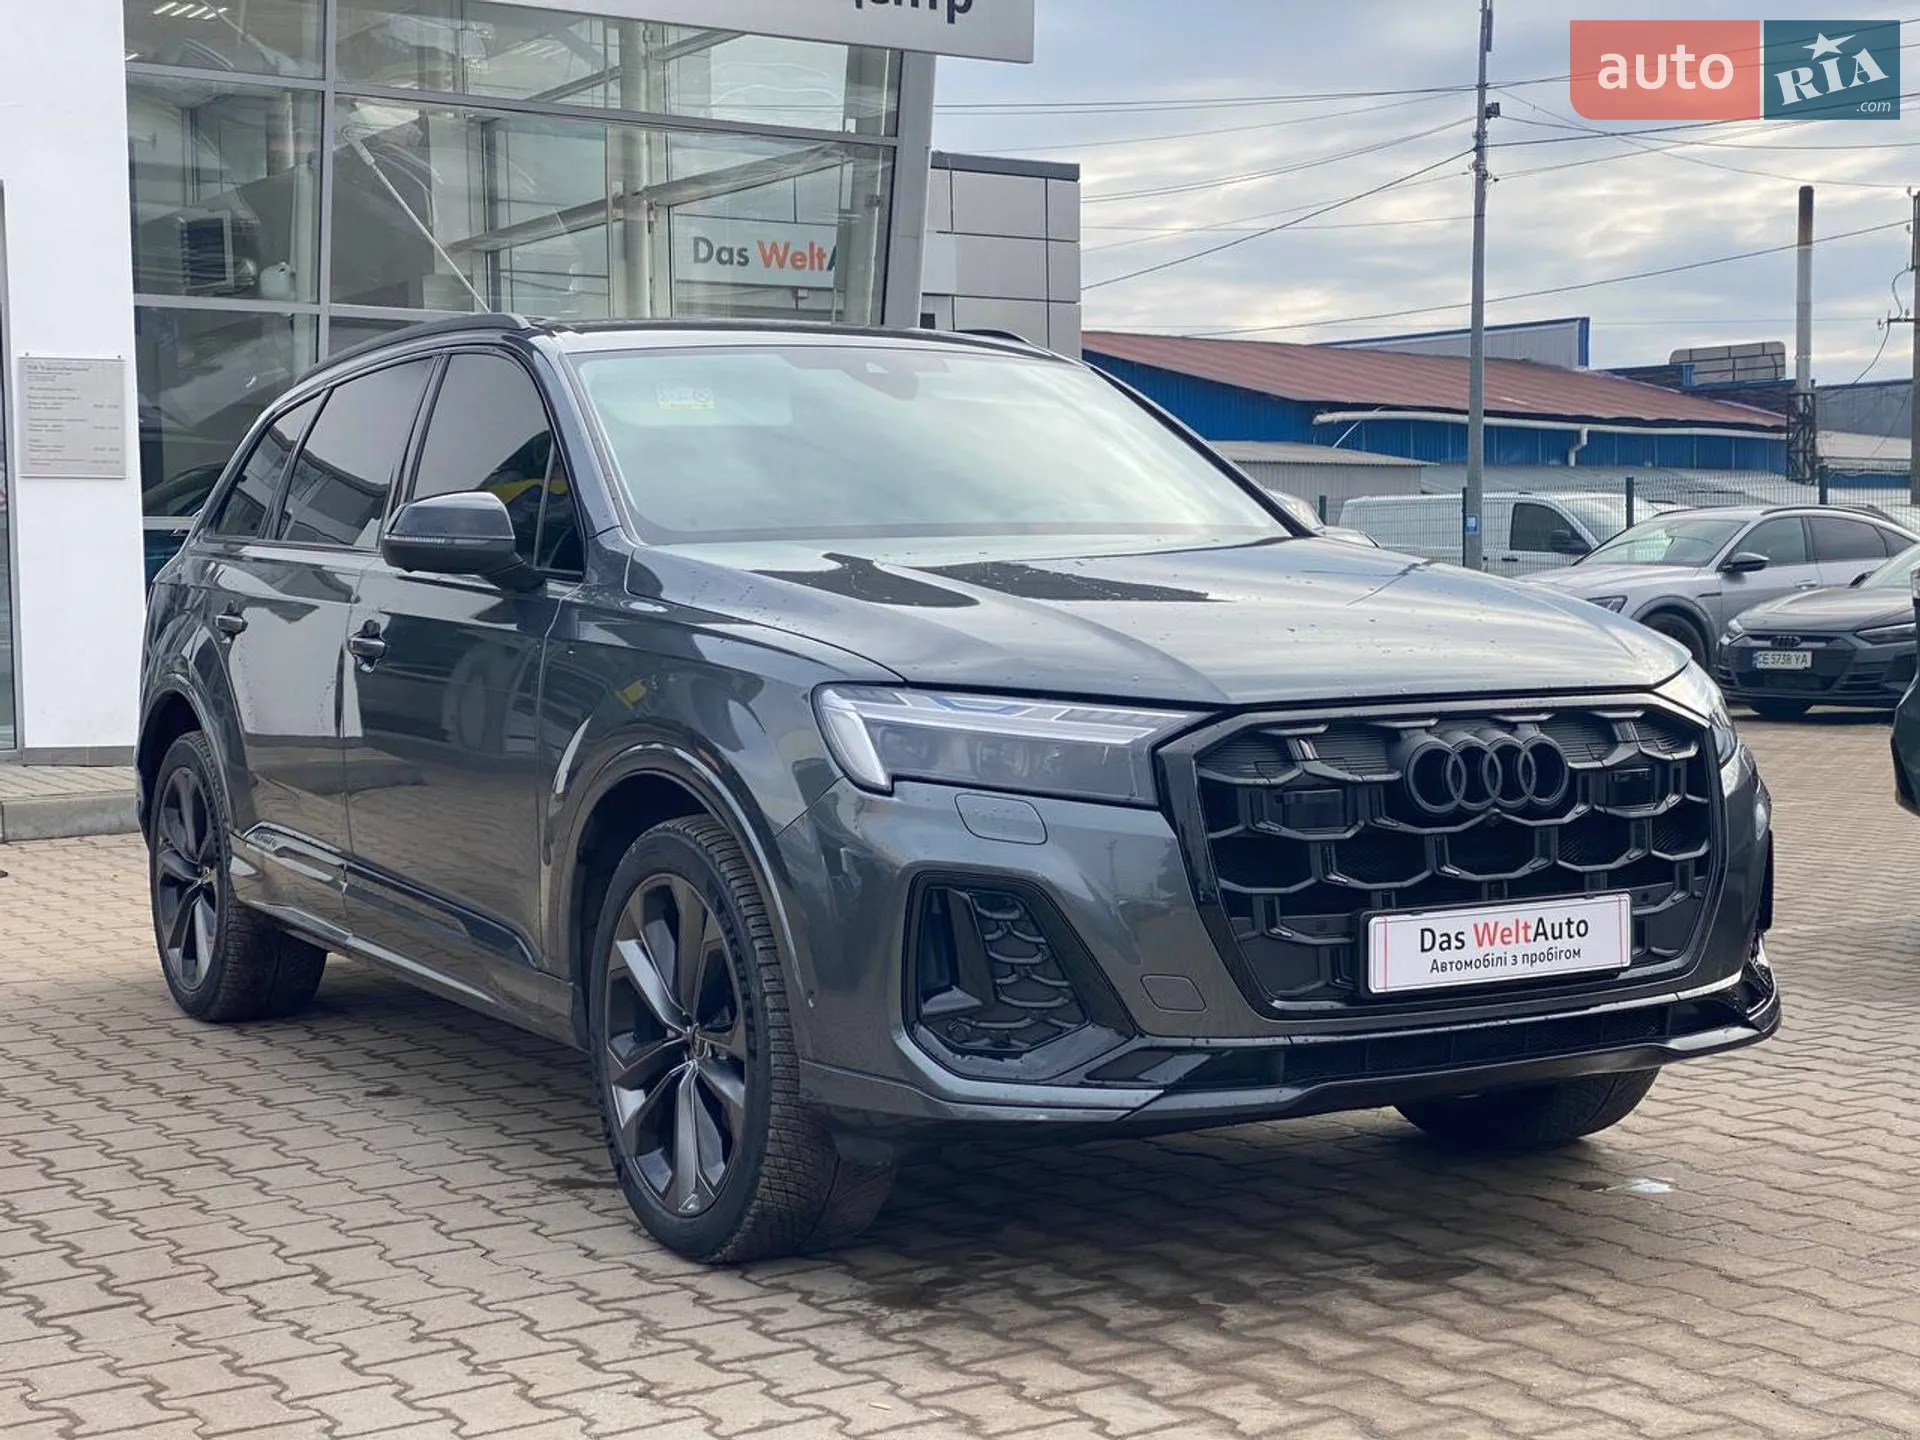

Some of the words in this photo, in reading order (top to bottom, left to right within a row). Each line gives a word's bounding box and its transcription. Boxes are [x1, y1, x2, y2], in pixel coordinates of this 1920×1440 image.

[693, 236, 750, 266] Das
[1420, 927, 1466, 953] Das
[1473, 916, 1589, 948] WeltAuto
[1429, 951, 1507, 974] Автомобілі
[1511, 954, 1518, 966] з
[1521, 946, 1581, 969] пробігом
